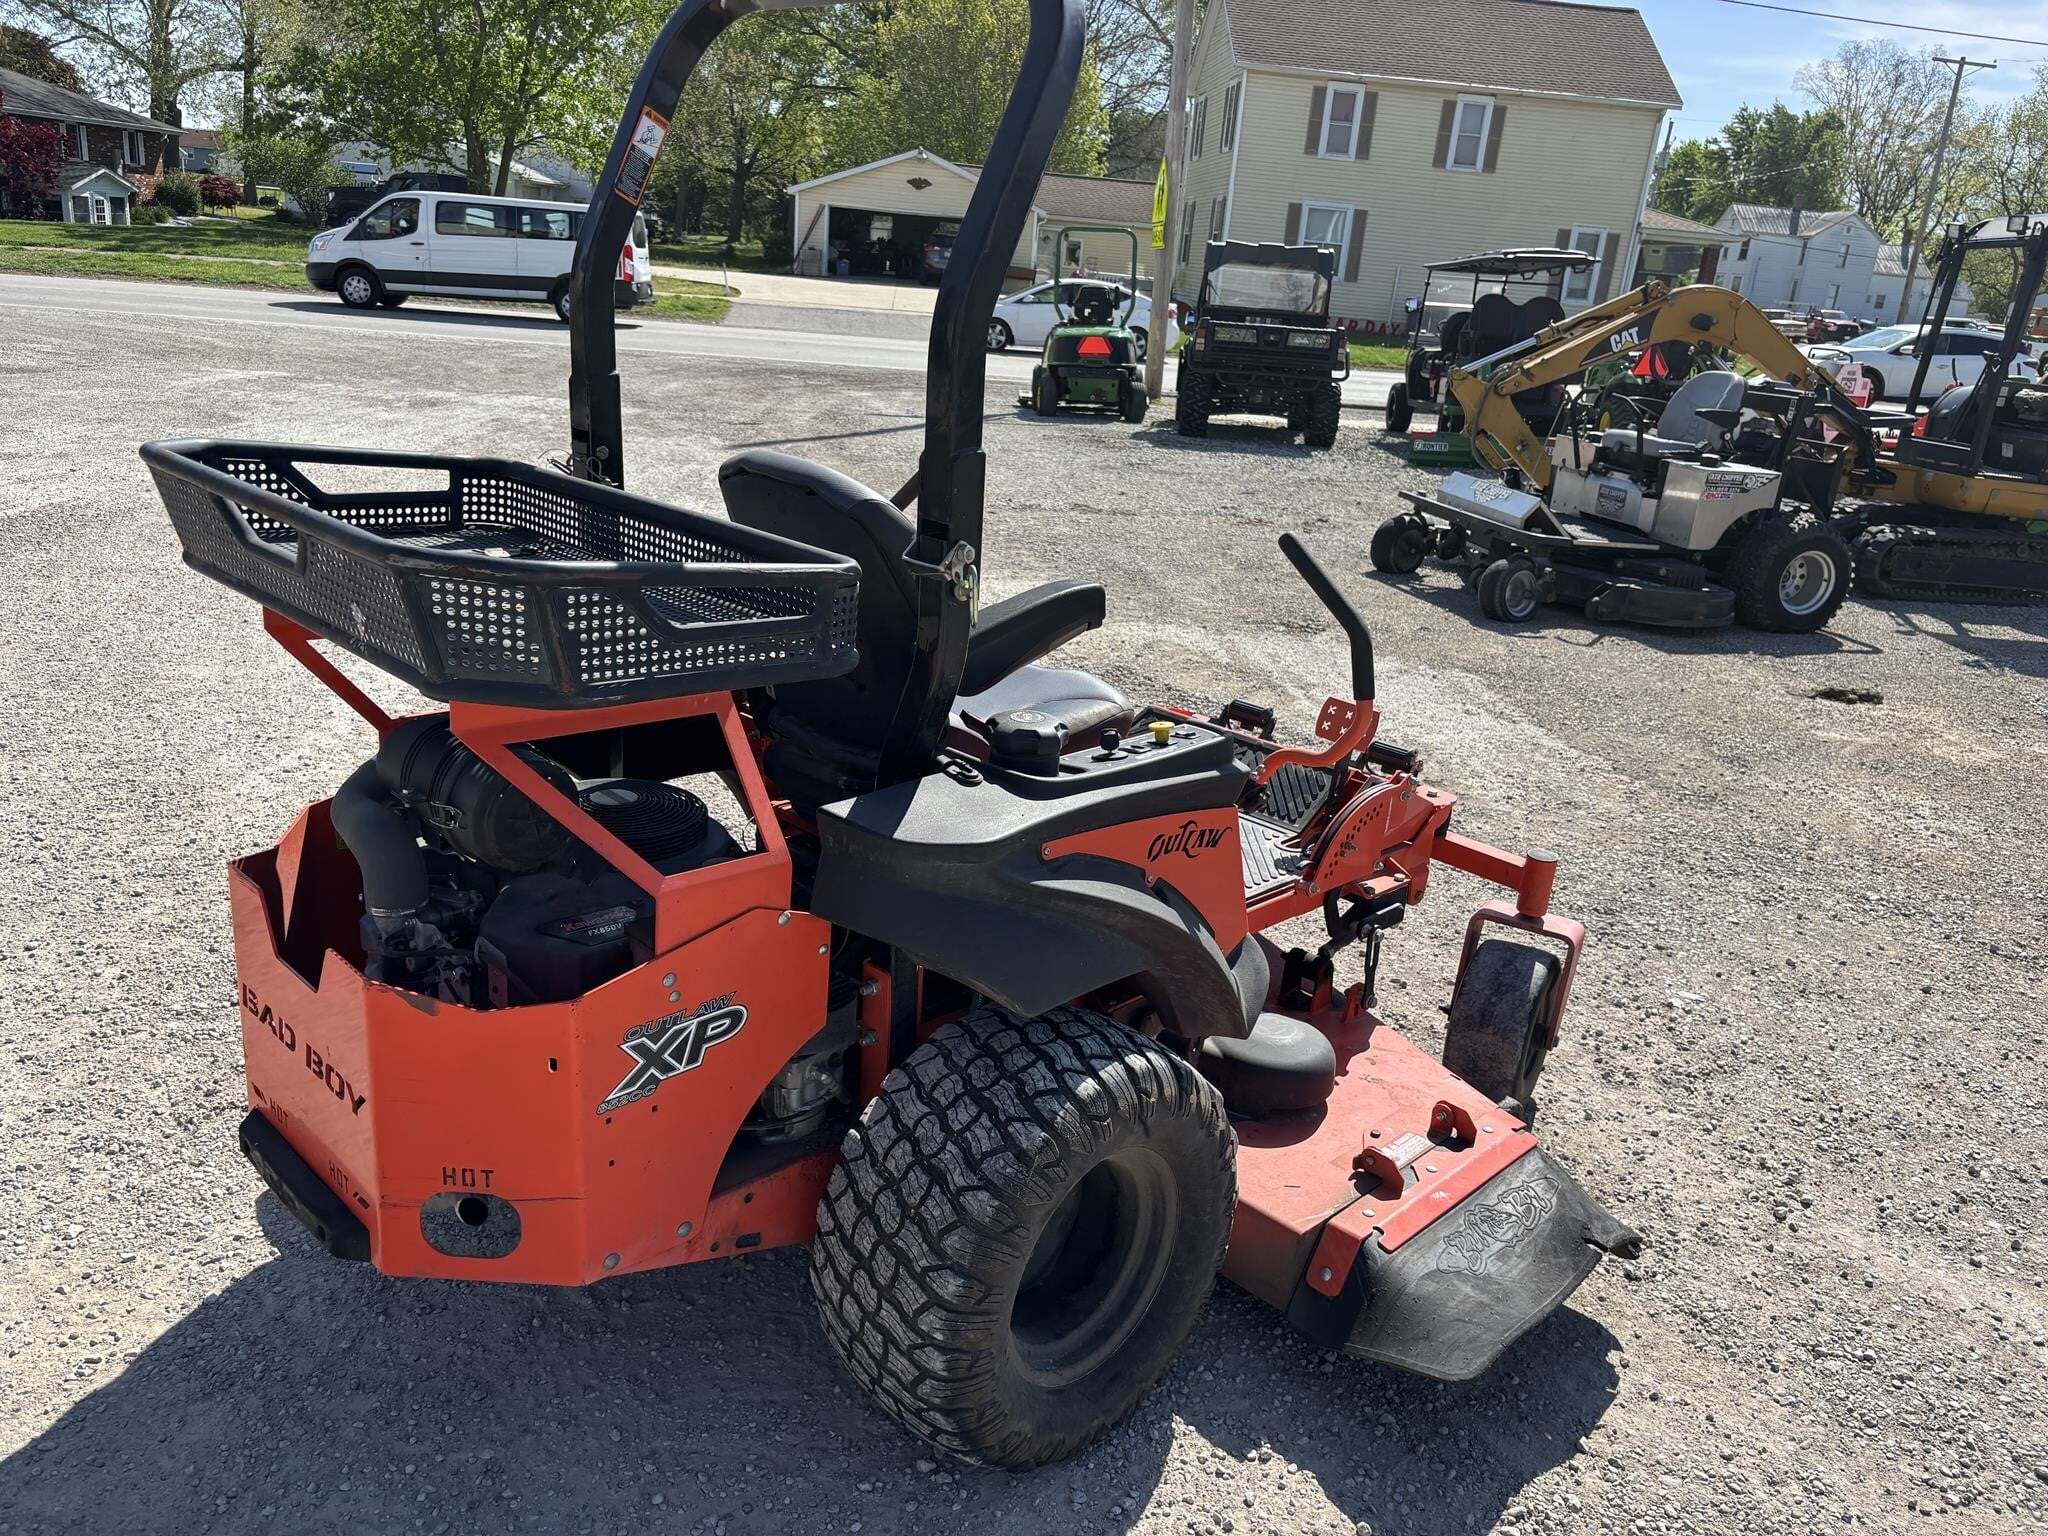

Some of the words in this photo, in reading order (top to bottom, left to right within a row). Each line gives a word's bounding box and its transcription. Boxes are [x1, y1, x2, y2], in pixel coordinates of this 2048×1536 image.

[1610, 326, 1640, 352] CAT
[1147, 819, 1233, 862] OUTLAW
[623, 991, 737, 1041] OUTLAW
[242, 982, 296, 1052] BAD
[305, 1042, 367, 1117] BOY
[605, 1004, 748, 1101] XP
[269, 1097, 289, 1129] HOT
[329, 1160, 349, 1193] HOT
[442, 1166, 494, 1188] HOT
